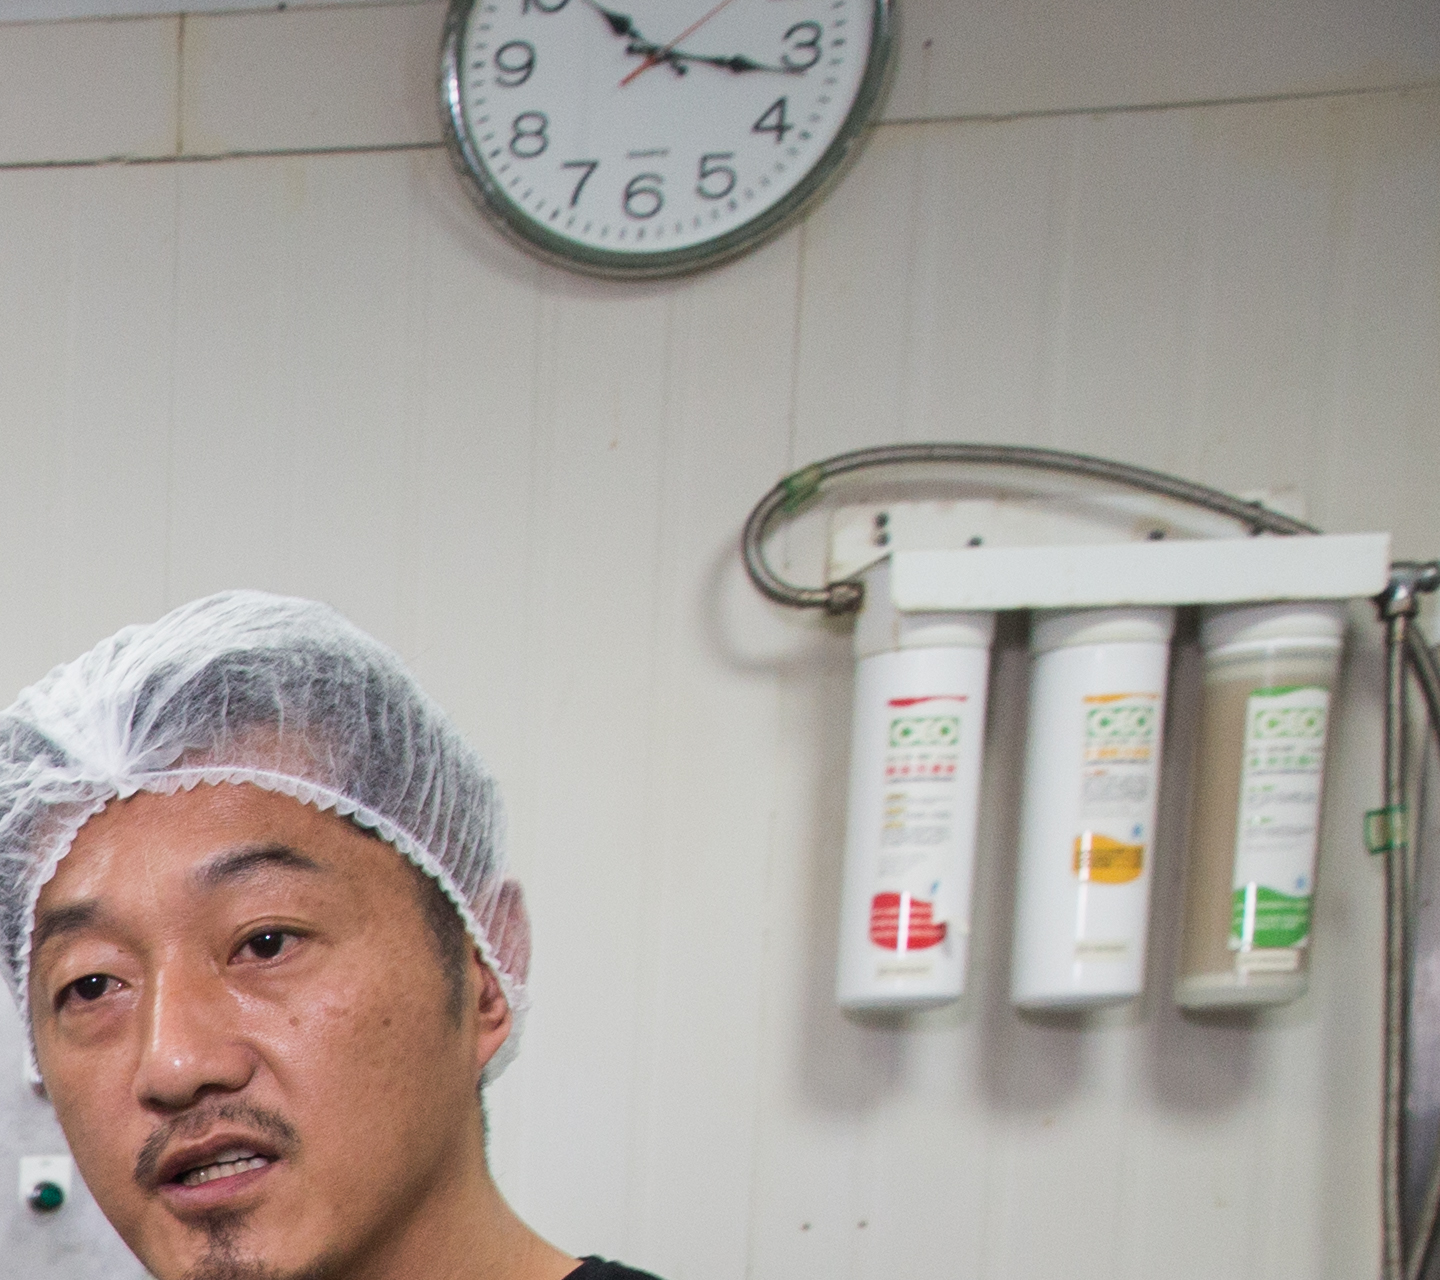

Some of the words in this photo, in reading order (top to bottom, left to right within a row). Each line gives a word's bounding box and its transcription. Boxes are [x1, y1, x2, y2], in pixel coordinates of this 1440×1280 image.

[494, 40, 536, 88] 9
[782, 20, 824, 72] 3
[510, 111, 549, 158] 8
[751, 97, 793, 143] 4
[561, 160, 599, 208] 7
[623, 172, 665, 219] 6
[696, 152, 737, 200] 5
